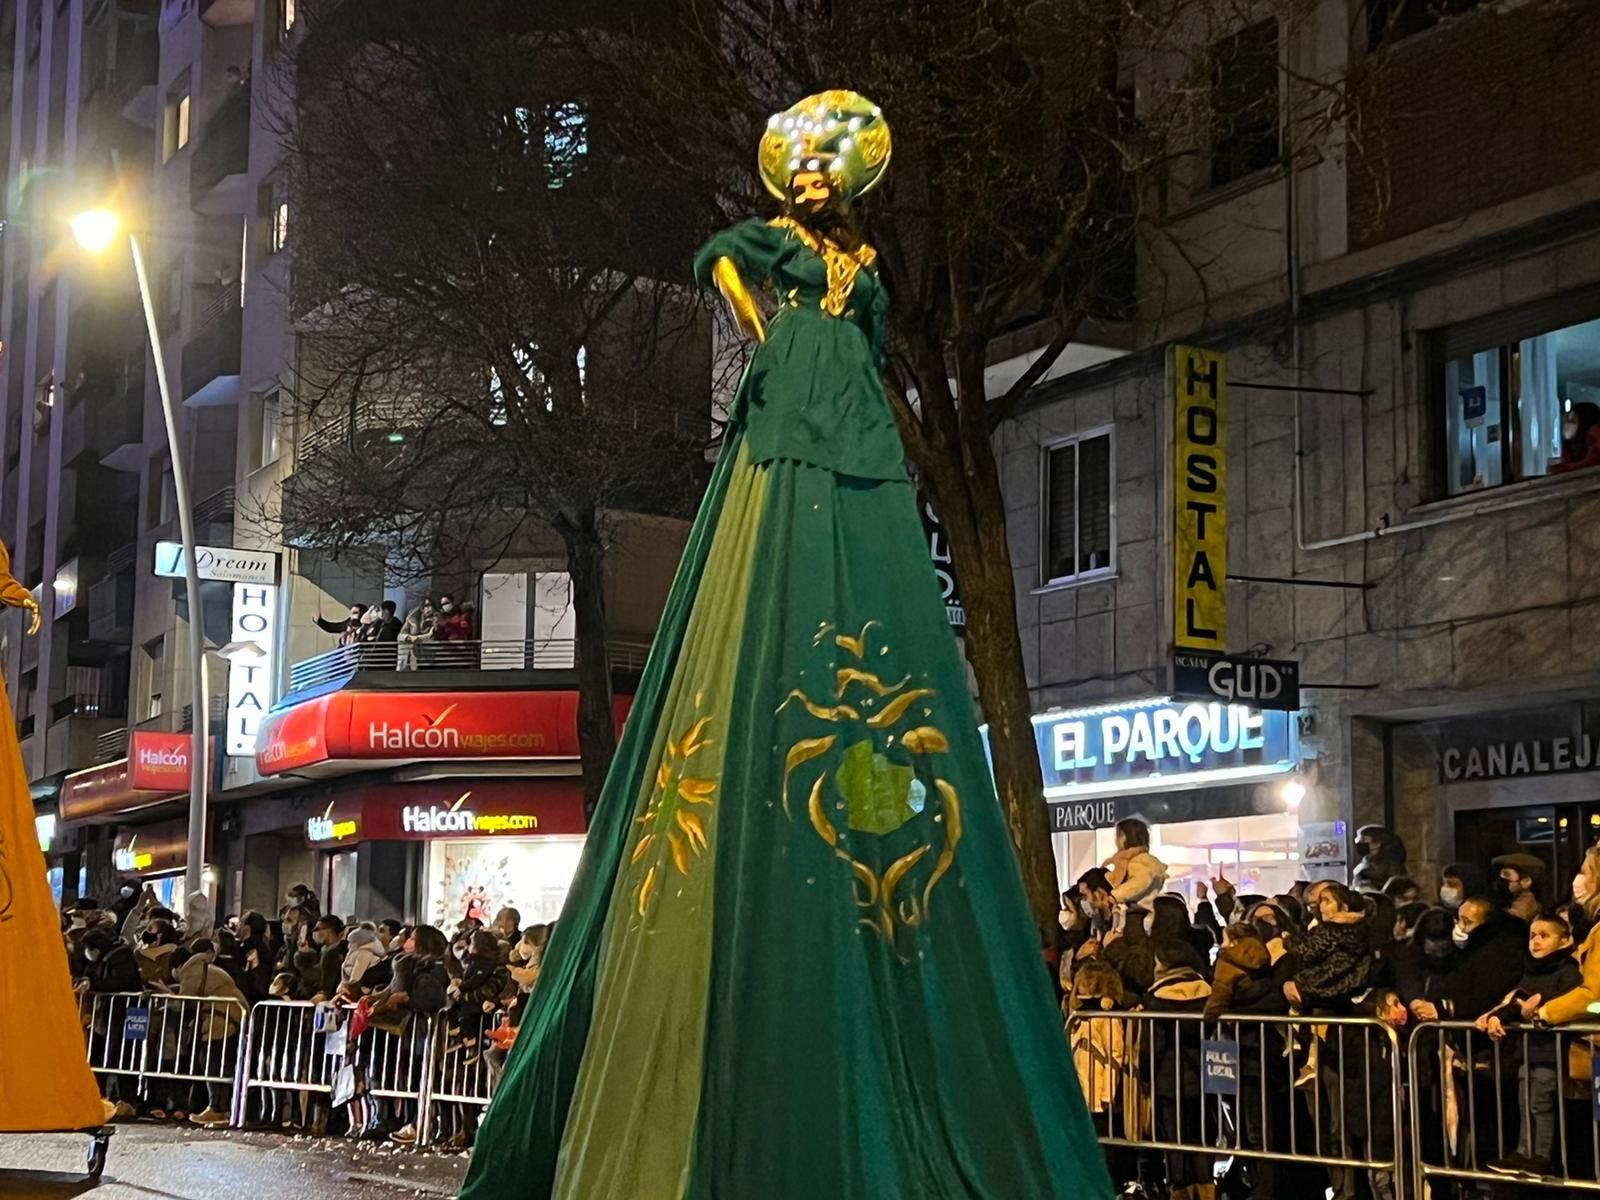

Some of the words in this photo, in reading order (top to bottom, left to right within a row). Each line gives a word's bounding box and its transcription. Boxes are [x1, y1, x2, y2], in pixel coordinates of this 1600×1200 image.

[1186, 357, 1218, 640] HOSTAL
[236, 588, 268, 735] HOTAL
[1053, 720, 1097, 771] EL
[1101, 702, 1265, 763] PARQUE
[1443, 734, 1600, 779] CANALEJ
[1056, 801, 1115, 828] PARQUE
